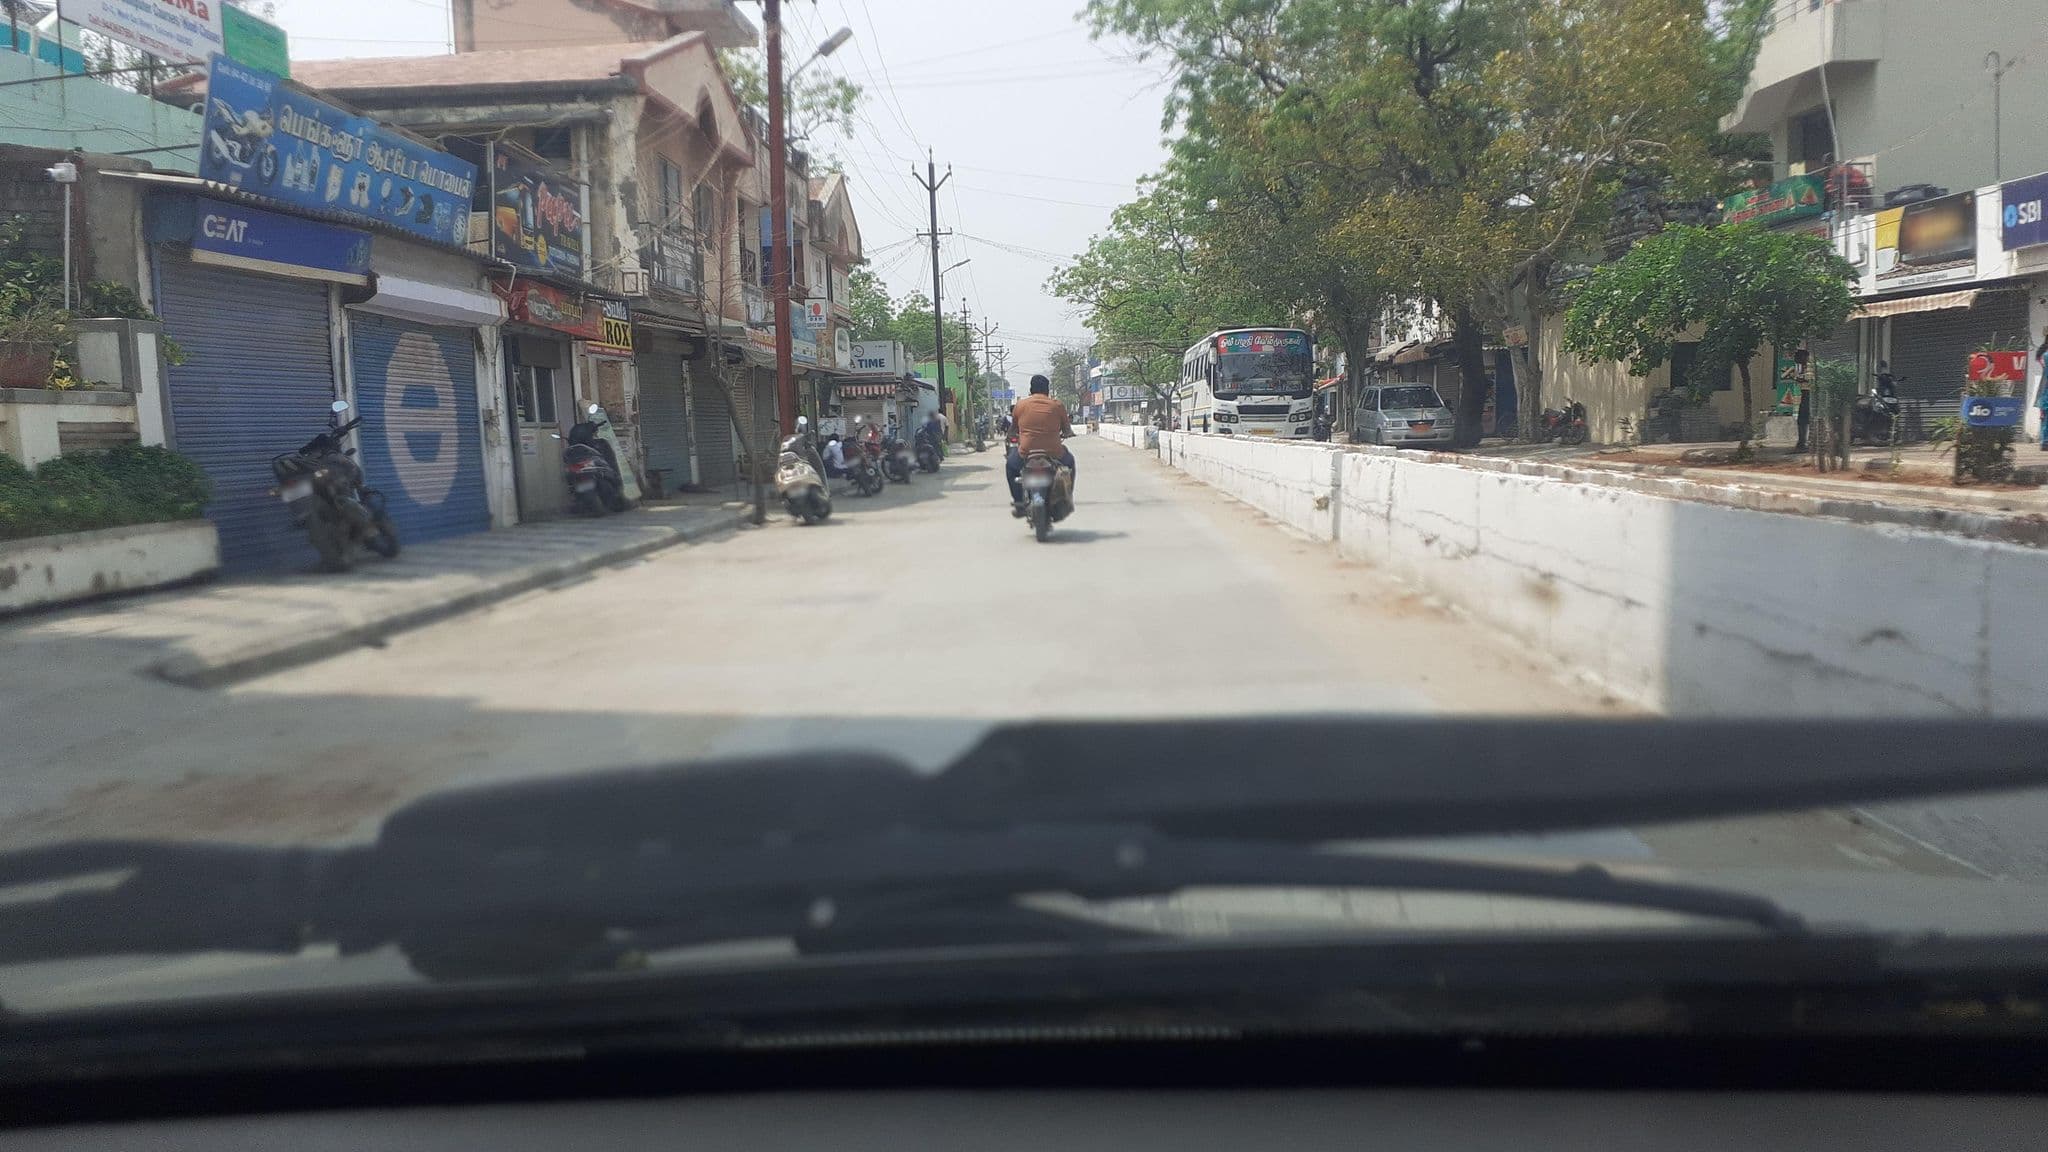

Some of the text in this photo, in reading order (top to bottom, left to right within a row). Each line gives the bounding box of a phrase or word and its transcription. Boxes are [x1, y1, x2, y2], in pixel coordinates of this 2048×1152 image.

[366, 140, 418, 180] ஆட்டோ
[2018, 199, 2042, 225] SBI
[203, 214, 248, 243] CEAT
[857, 358, 886, 369] TIME
[1969, 405, 1991, 417] Jio
